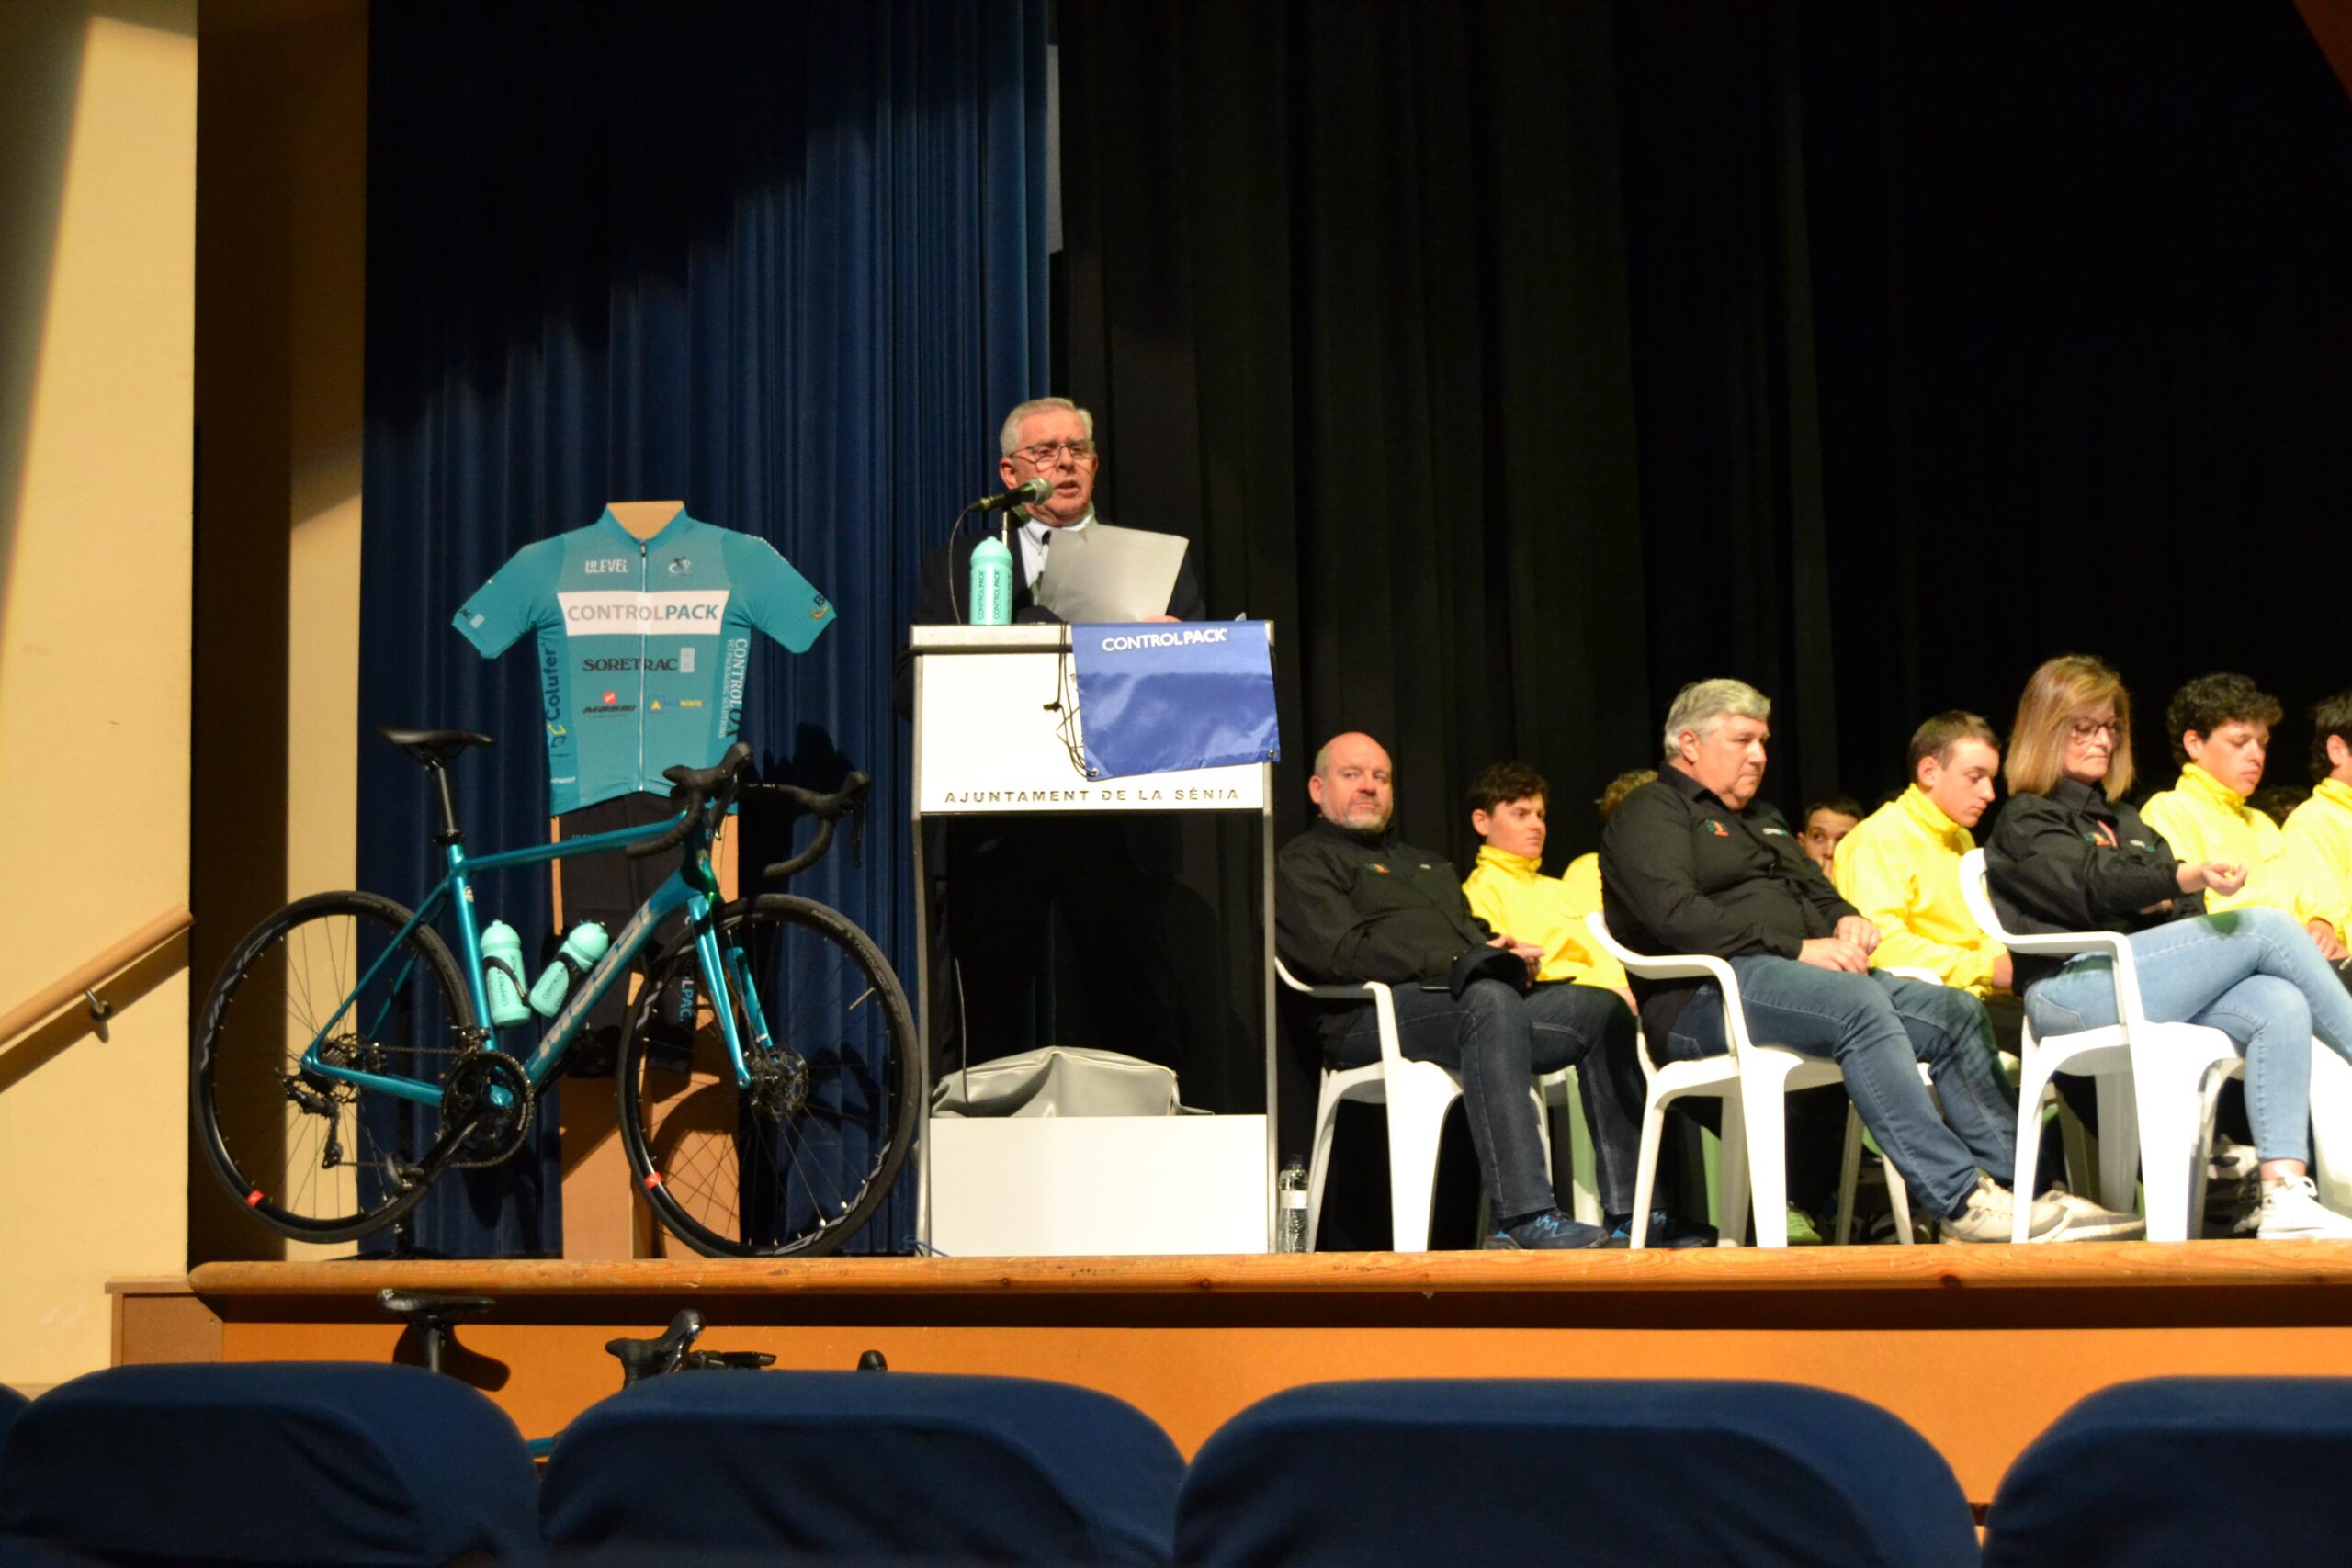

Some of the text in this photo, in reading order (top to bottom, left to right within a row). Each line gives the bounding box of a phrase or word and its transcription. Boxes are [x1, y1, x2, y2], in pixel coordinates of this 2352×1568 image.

[568, 604, 719, 621] CONTROLPACK
[1102, 628, 1227, 651] CONTROLPACK
[582, 658, 678, 672] SORETRAC
[543, 648, 560, 722] Colufer
[944, 787, 1239, 804] AJUNTAMENT DE LA SÉNIA
